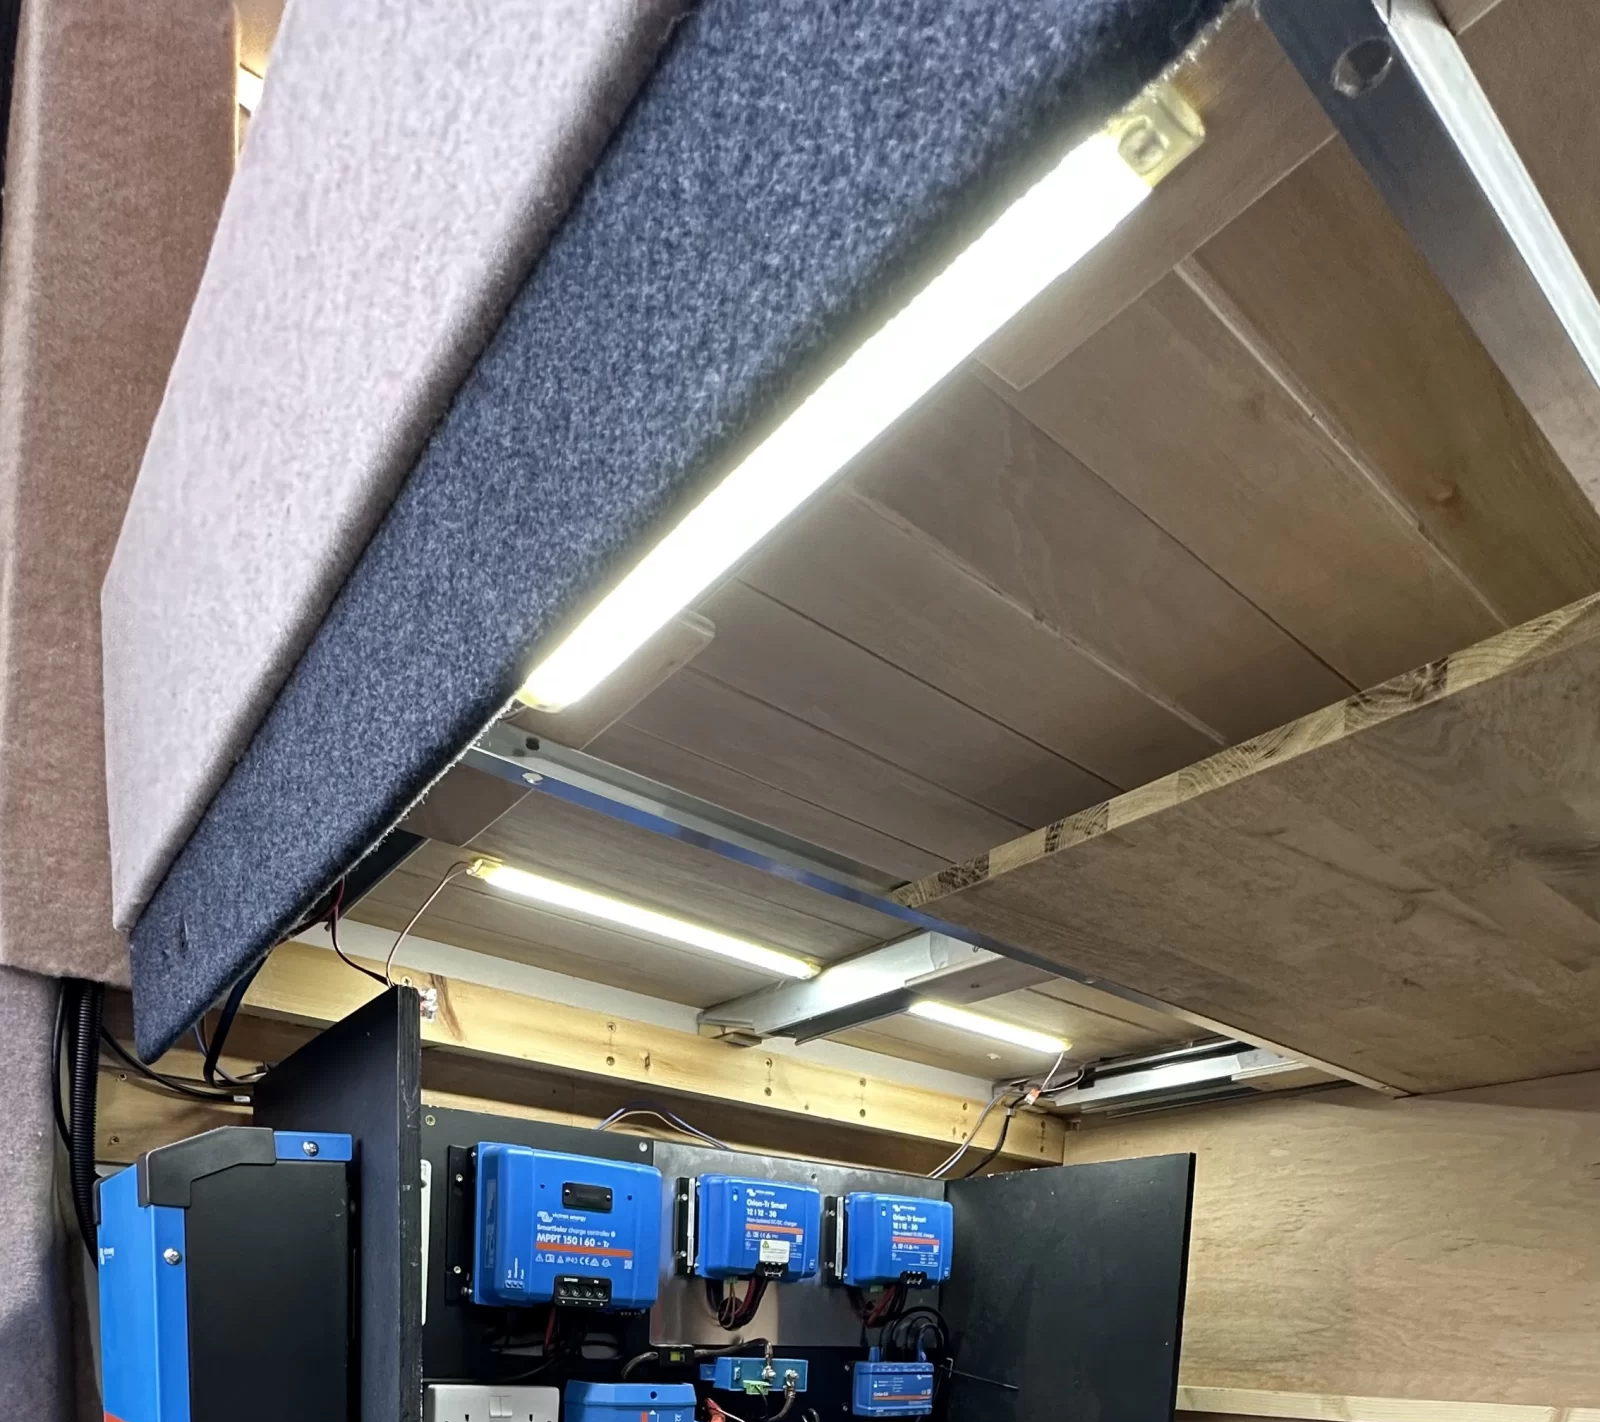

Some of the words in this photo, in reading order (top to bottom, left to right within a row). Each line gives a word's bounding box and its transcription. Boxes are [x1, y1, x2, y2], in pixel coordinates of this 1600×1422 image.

[770, 1201, 788, 1210] Smart
[537, 1224, 568, 1234] SmartSolar
[537, 1233, 561, 1244] MPPT
[563, 1235, 578, 1246] 150
[584, 1237, 595, 1247] 60
